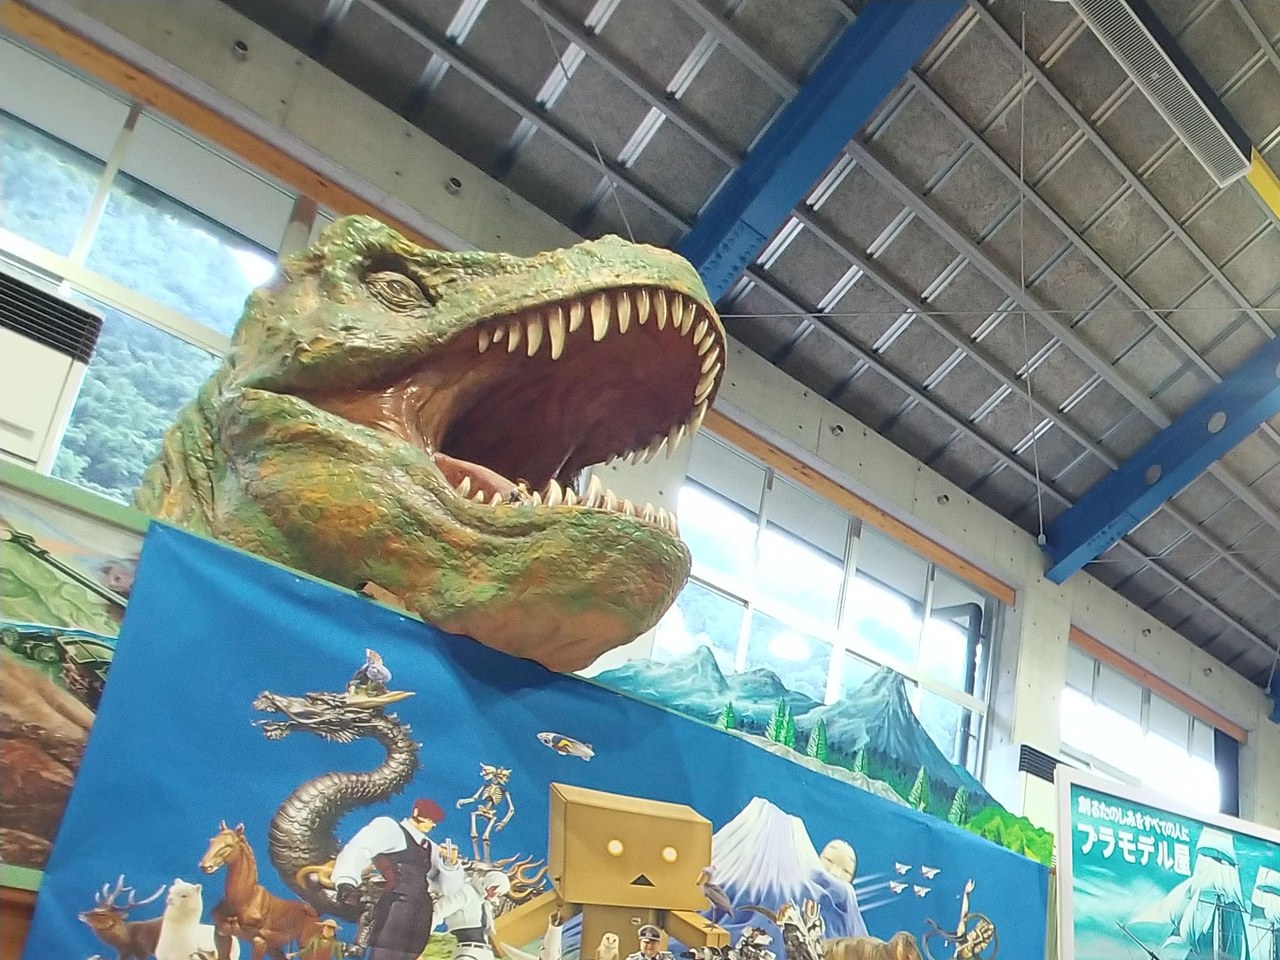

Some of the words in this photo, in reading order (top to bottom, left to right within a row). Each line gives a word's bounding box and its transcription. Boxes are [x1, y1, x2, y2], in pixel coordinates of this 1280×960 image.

[1077, 823, 1192, 877] プラモデル屋
